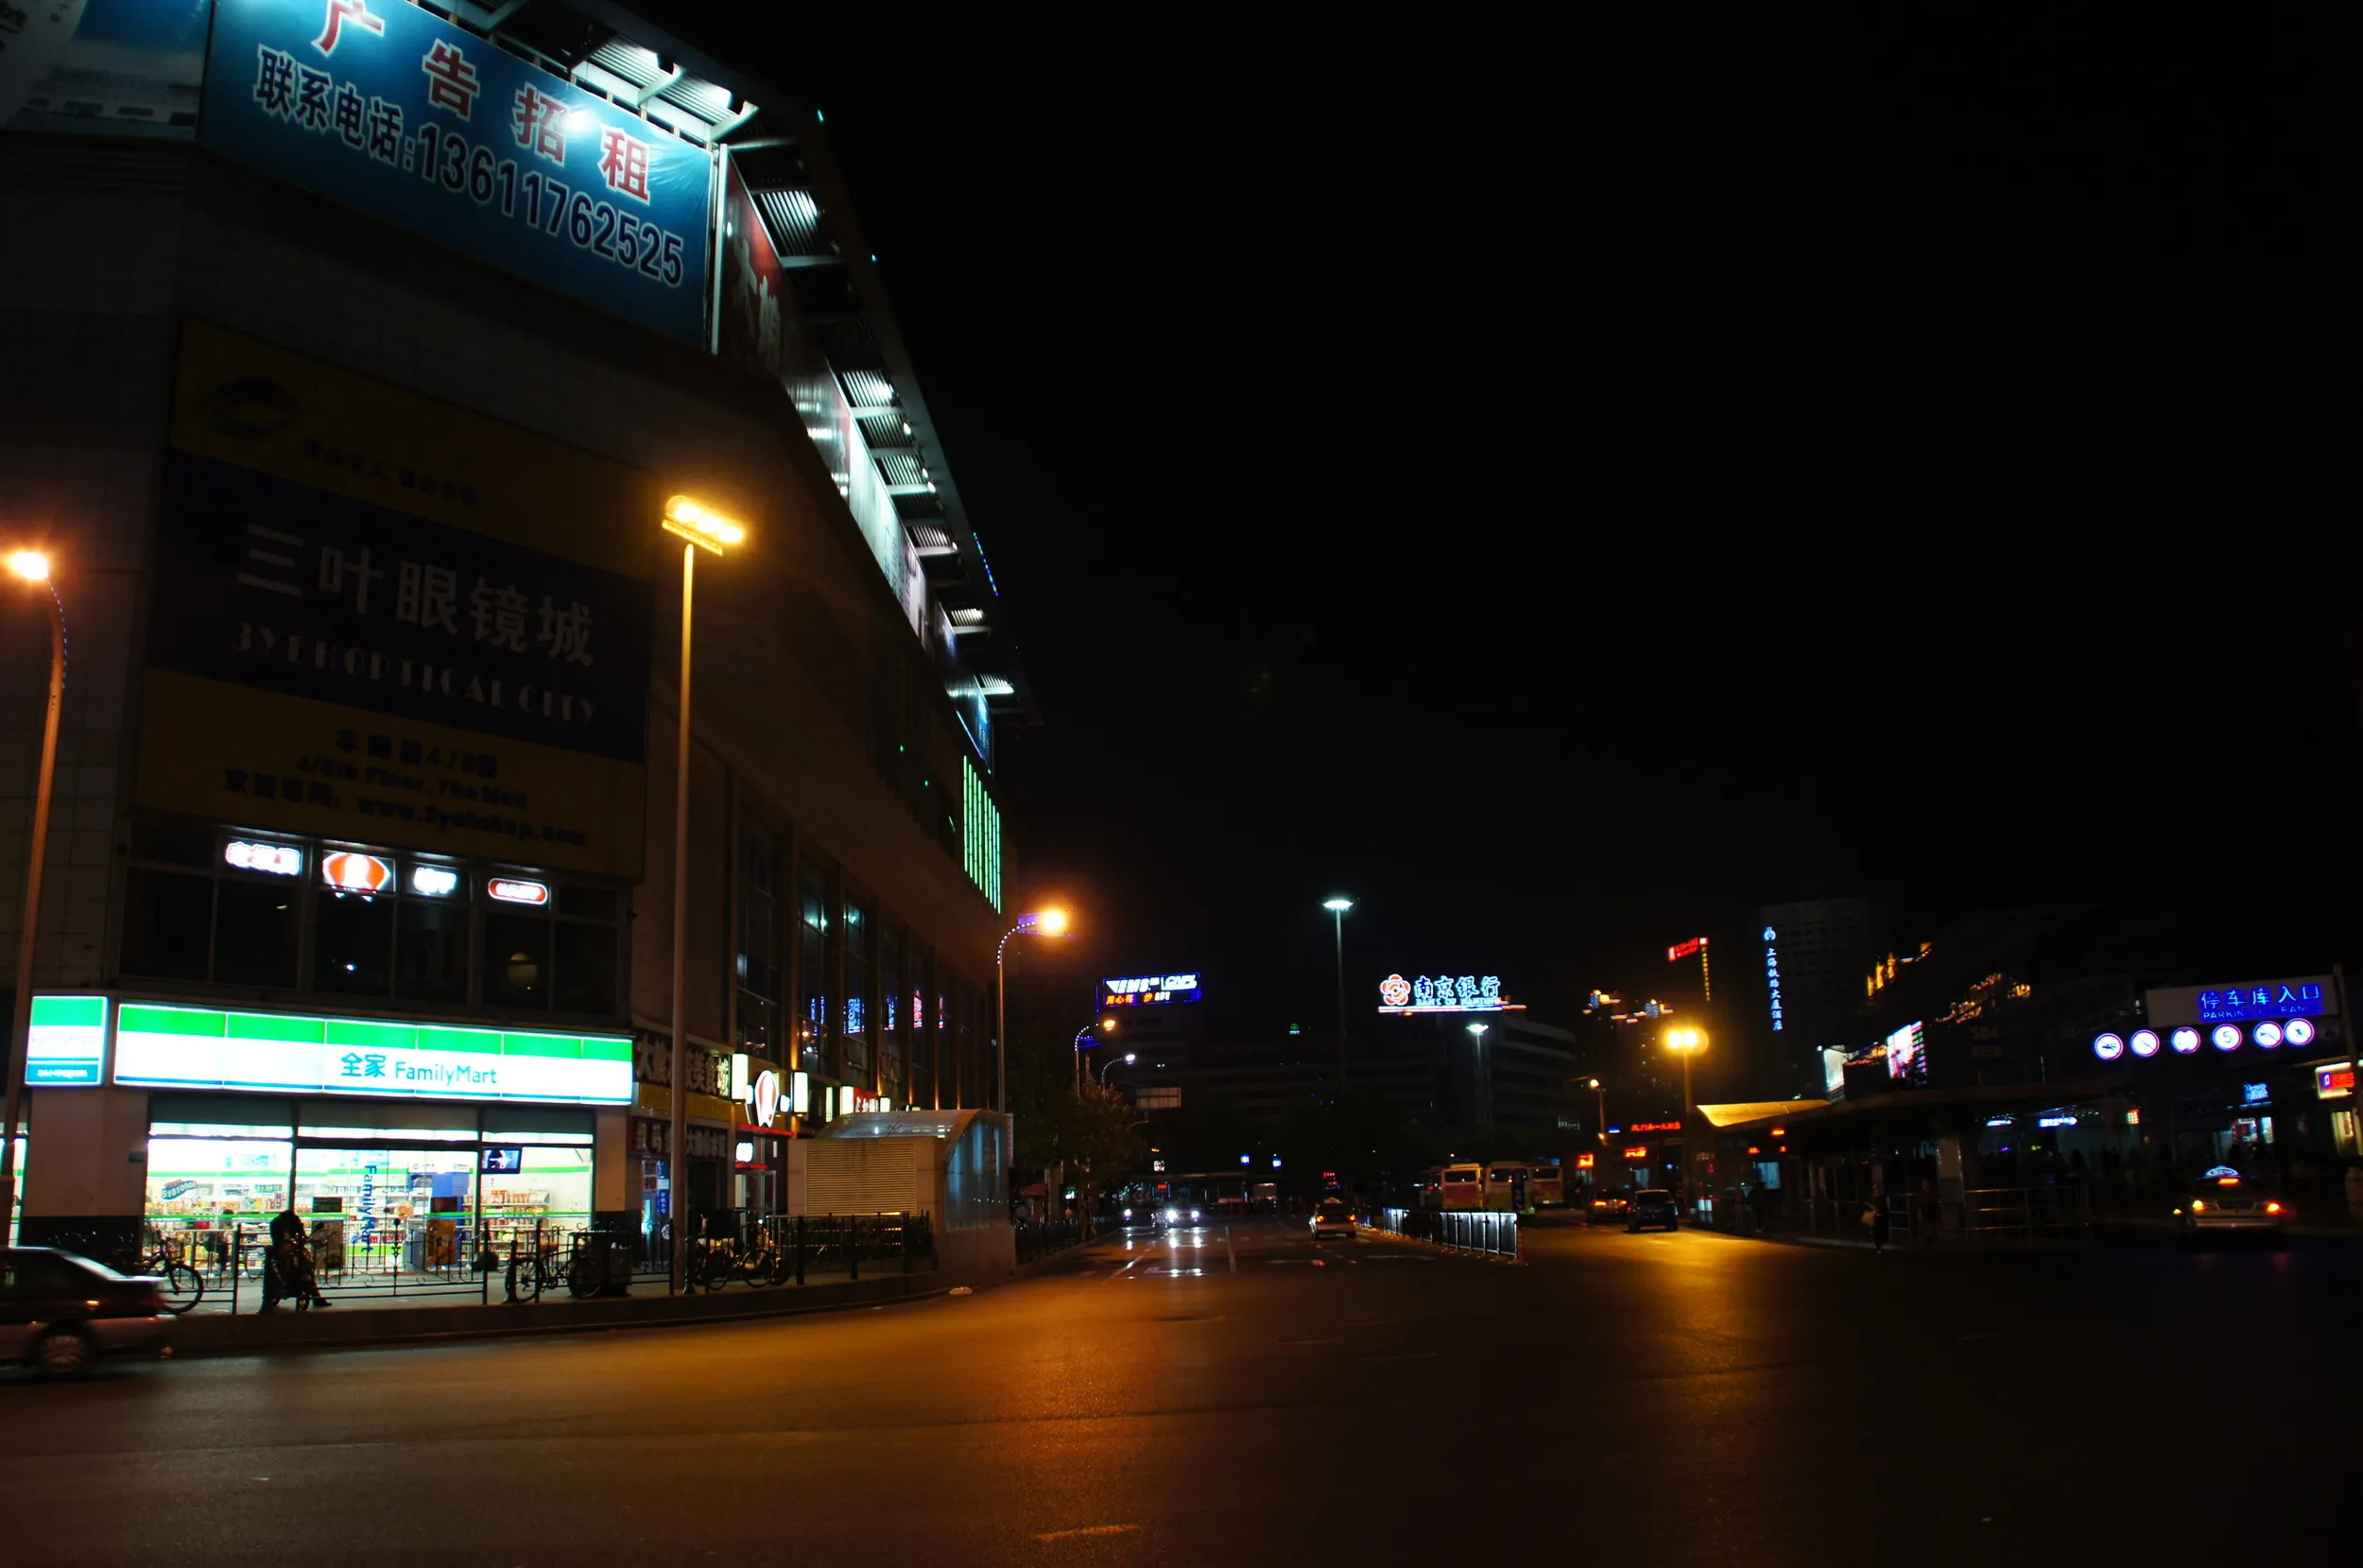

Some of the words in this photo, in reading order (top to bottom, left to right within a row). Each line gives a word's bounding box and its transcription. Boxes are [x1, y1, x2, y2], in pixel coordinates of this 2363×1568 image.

[312, 0, 651, 205] 广告招租
[253, 43, 684, 288] 联系电话:13611762525
[237, 522, 595, 667] 三叶眼镜城
[517, 683, 597, 726] CITY
[1414, 975, 1501, 998] 南京银行
[1767, 947, 1783, 1031] 上海铁路大厦酒店
[2200, 985, 2320, 1009] 停车库入口
[2203, 1008, 2251, 1019] PARKIN
[340, 1052, 387, 1077] 全家
[394, 1060, 498, 1087] FamilyMart
[357, 1164, 377, 1252] FamilyMart
